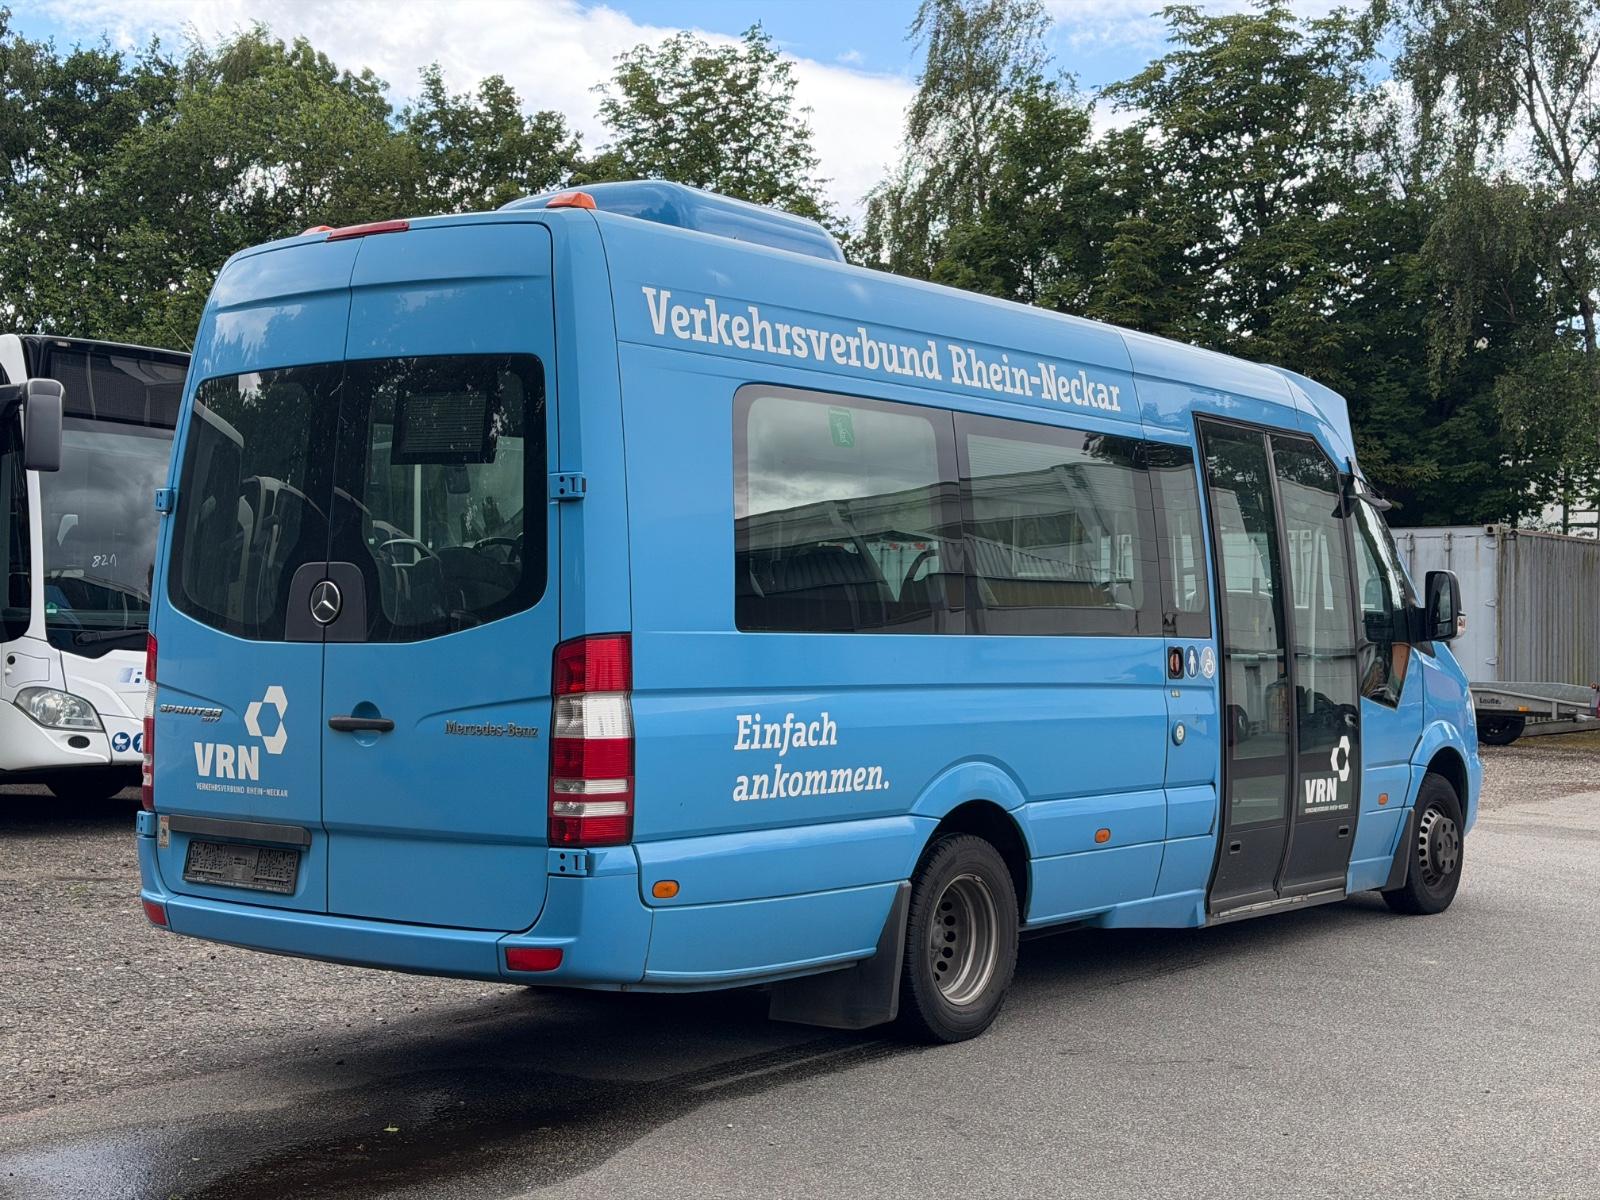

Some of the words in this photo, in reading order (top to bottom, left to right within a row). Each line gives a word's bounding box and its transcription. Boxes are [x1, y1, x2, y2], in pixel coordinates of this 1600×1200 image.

[642, 286, 942, 382] Verkehrsverbund
[949, 345, 1121, 413] Rhein-Neckar
[159, 704, 222, 717] SPRINTER
[446, 719, 538, 737] Mercedes-Benz
[734, 712, 837, 757] Einfach
[194, 742, 259, 780] VRN
[196, 782, 245, 794] VERKEHRSVERBUND
[246, 786, 289, 797] RHEIN-NECKAR
[733, 763, 890, 802] ankommen.
[1305, 778, 1337, 803] VRN
